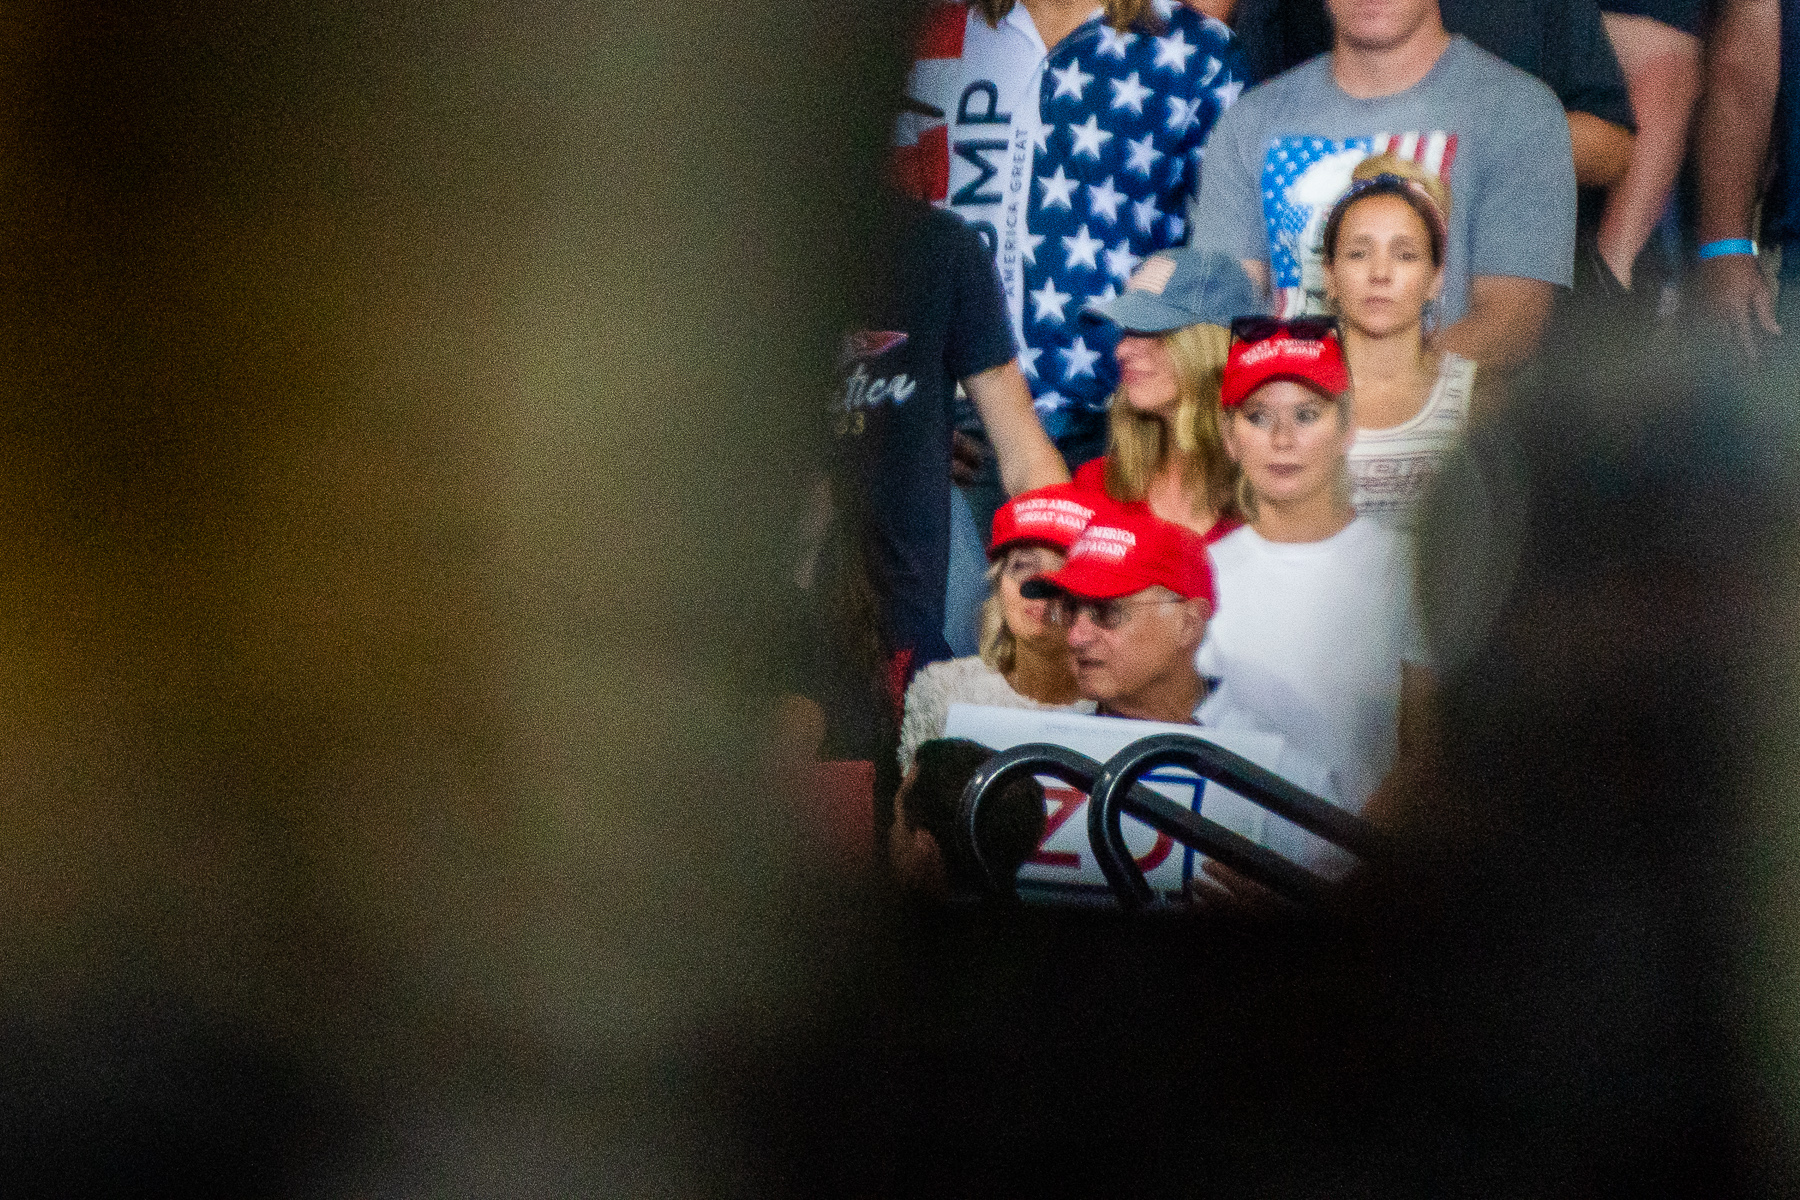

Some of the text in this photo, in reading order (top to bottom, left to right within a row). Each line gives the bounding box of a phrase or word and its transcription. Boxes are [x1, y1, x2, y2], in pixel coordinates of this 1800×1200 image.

[1009, 127, 1029, 193] GREAT
[1014, 498, 1047, 514] MAKE
[1017, 511, 1055, 524] GREAT
